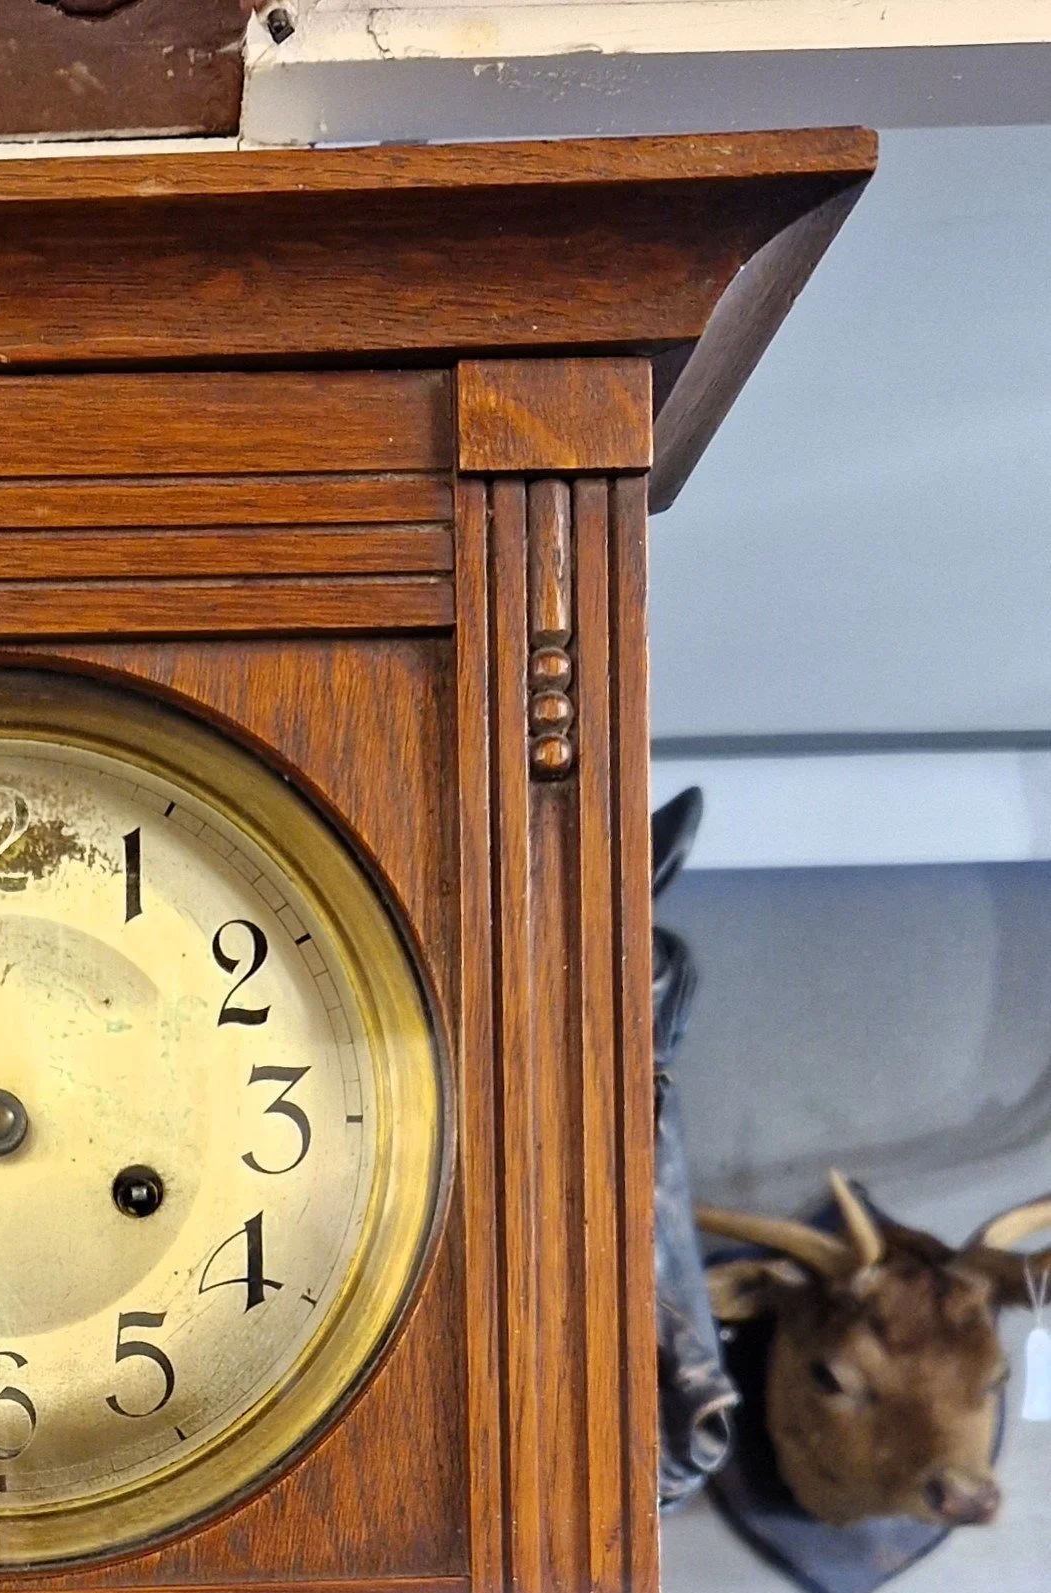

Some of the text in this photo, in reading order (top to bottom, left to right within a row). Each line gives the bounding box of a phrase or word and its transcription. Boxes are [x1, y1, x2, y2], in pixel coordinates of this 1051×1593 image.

[123, 826, 142, 925] 1
[211, 918, 272, 1028] 2
[241, 1064, 313, 1175] 3
[198, 1210, 285, 1314] 4
[105, 1311, 177, 1419] 5
